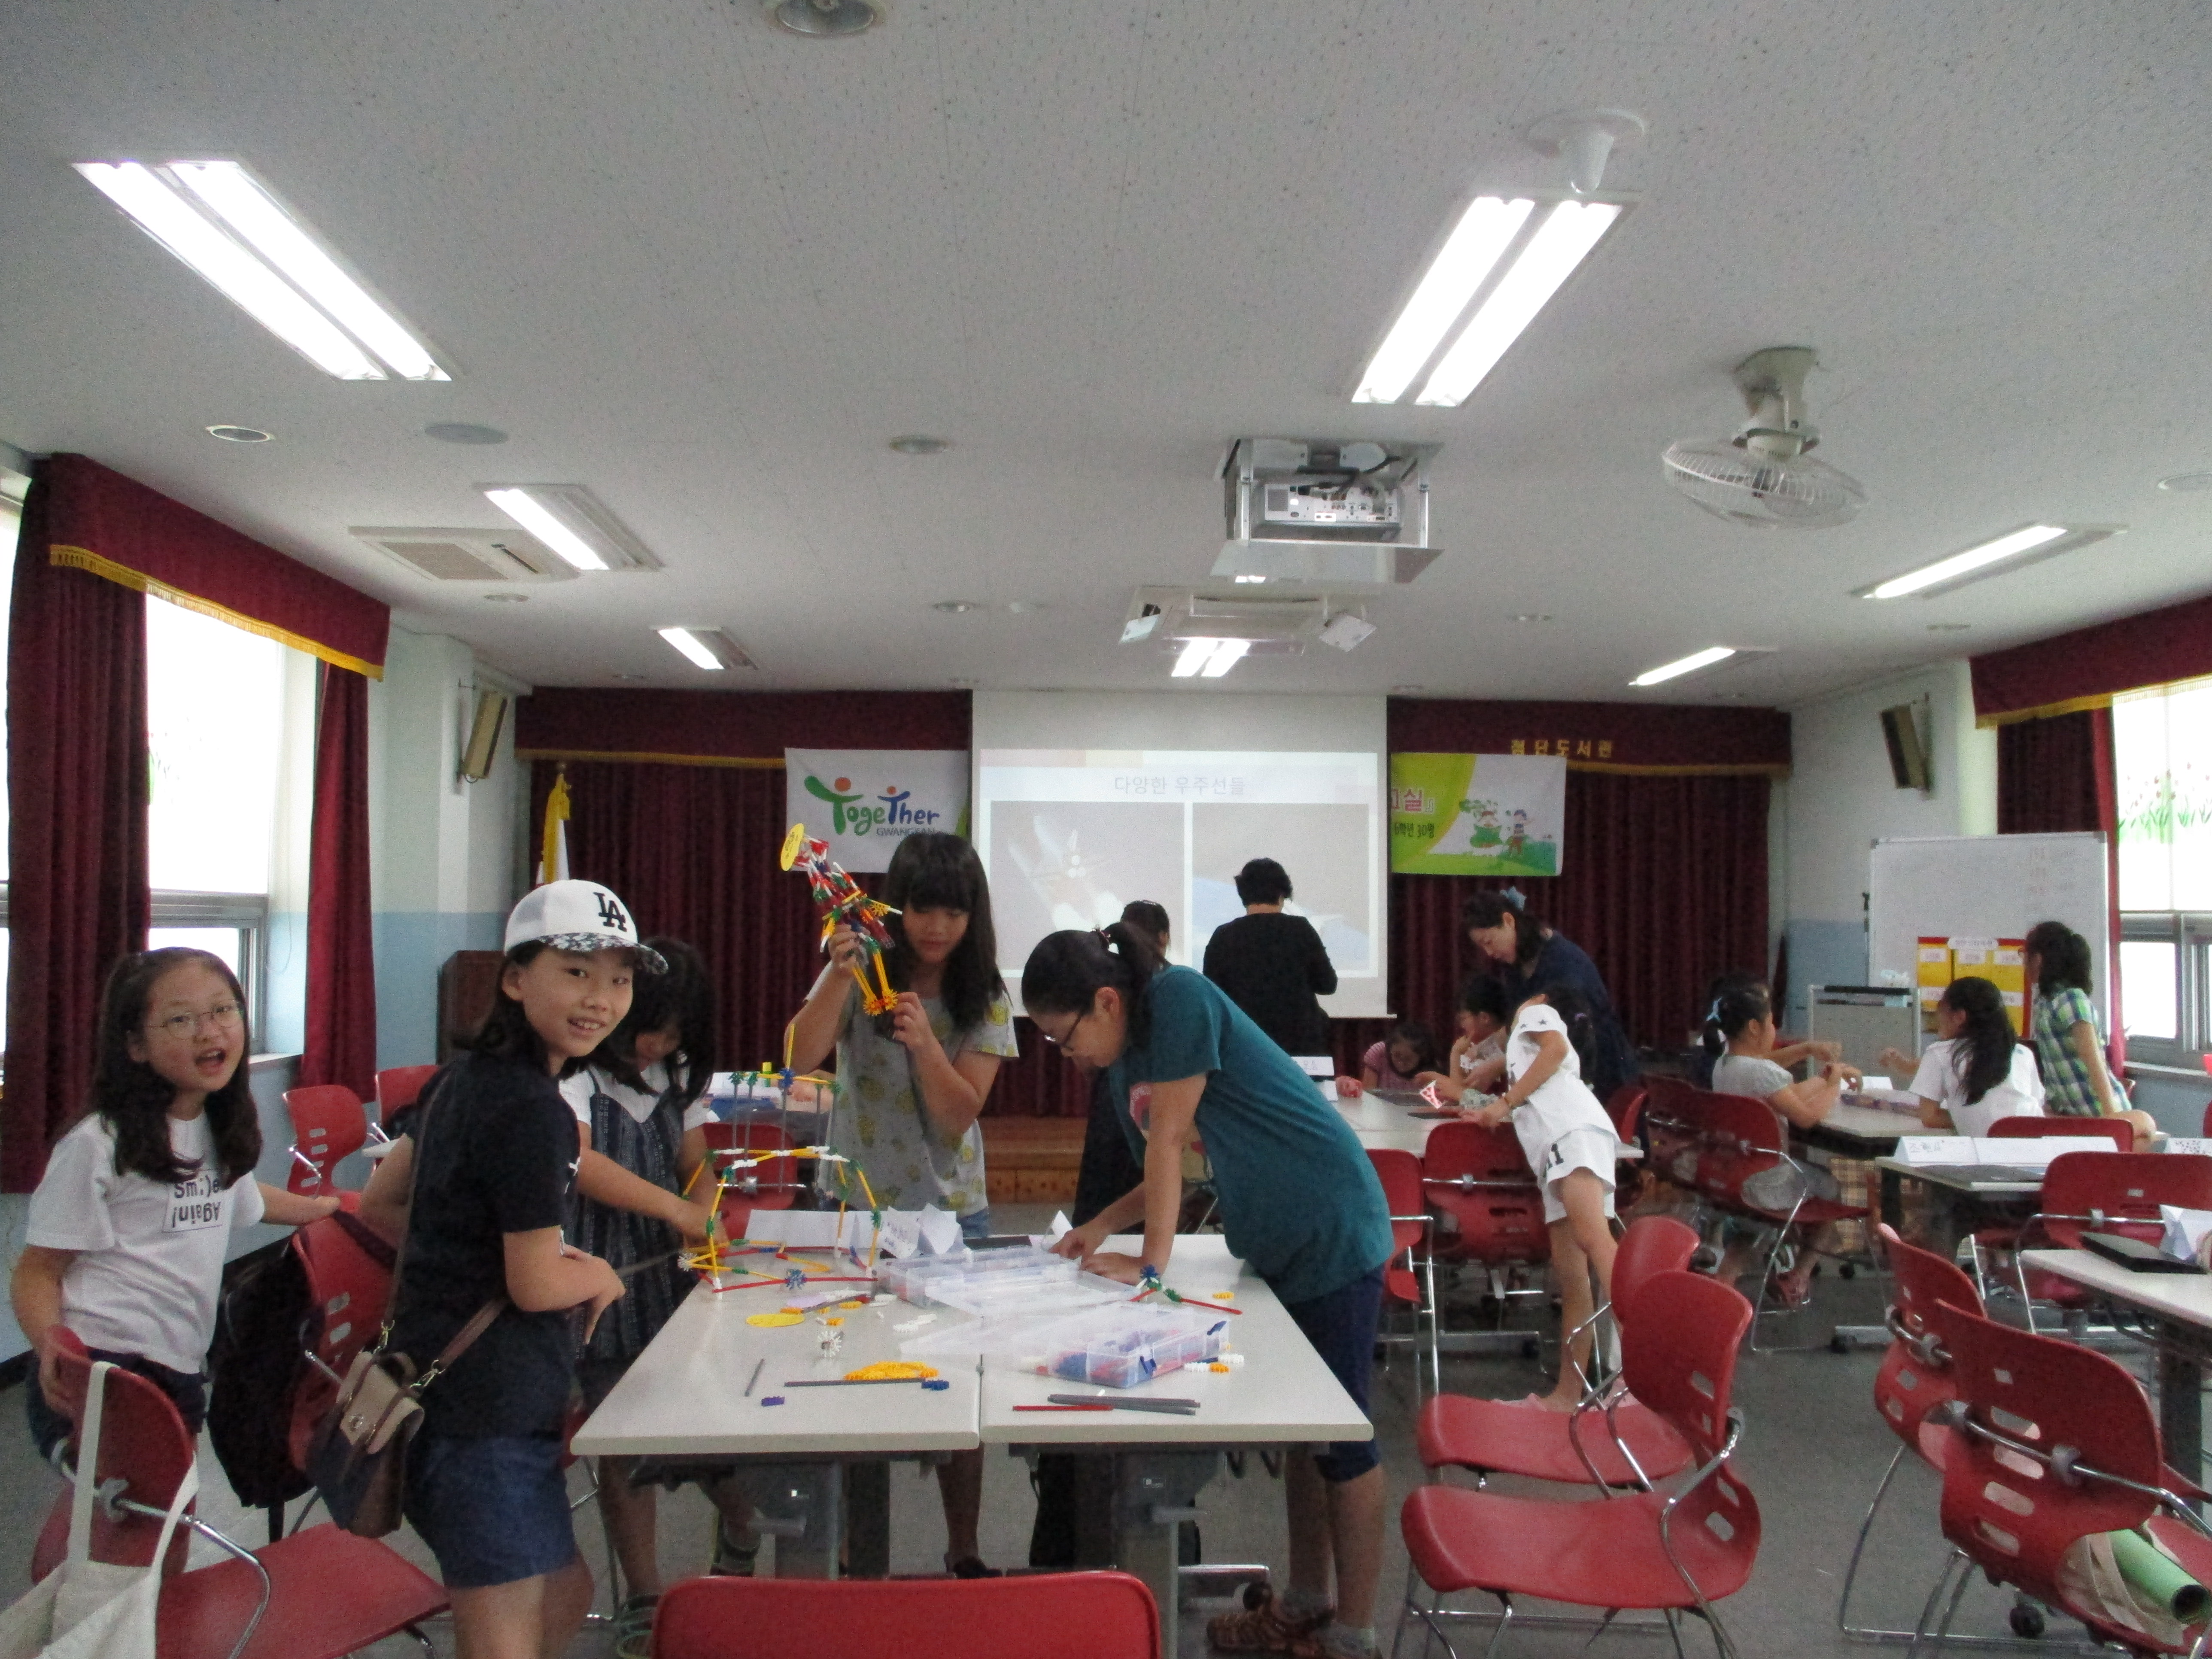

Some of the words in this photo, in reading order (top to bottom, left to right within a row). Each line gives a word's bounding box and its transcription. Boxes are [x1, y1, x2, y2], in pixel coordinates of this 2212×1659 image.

[1114, 775, 1168, 795] 다양한
[1174, 776, 1246, 796] 우주선들
[592, 891, 627, 933] LA
[172, 1201, 222, 1229] Again!
